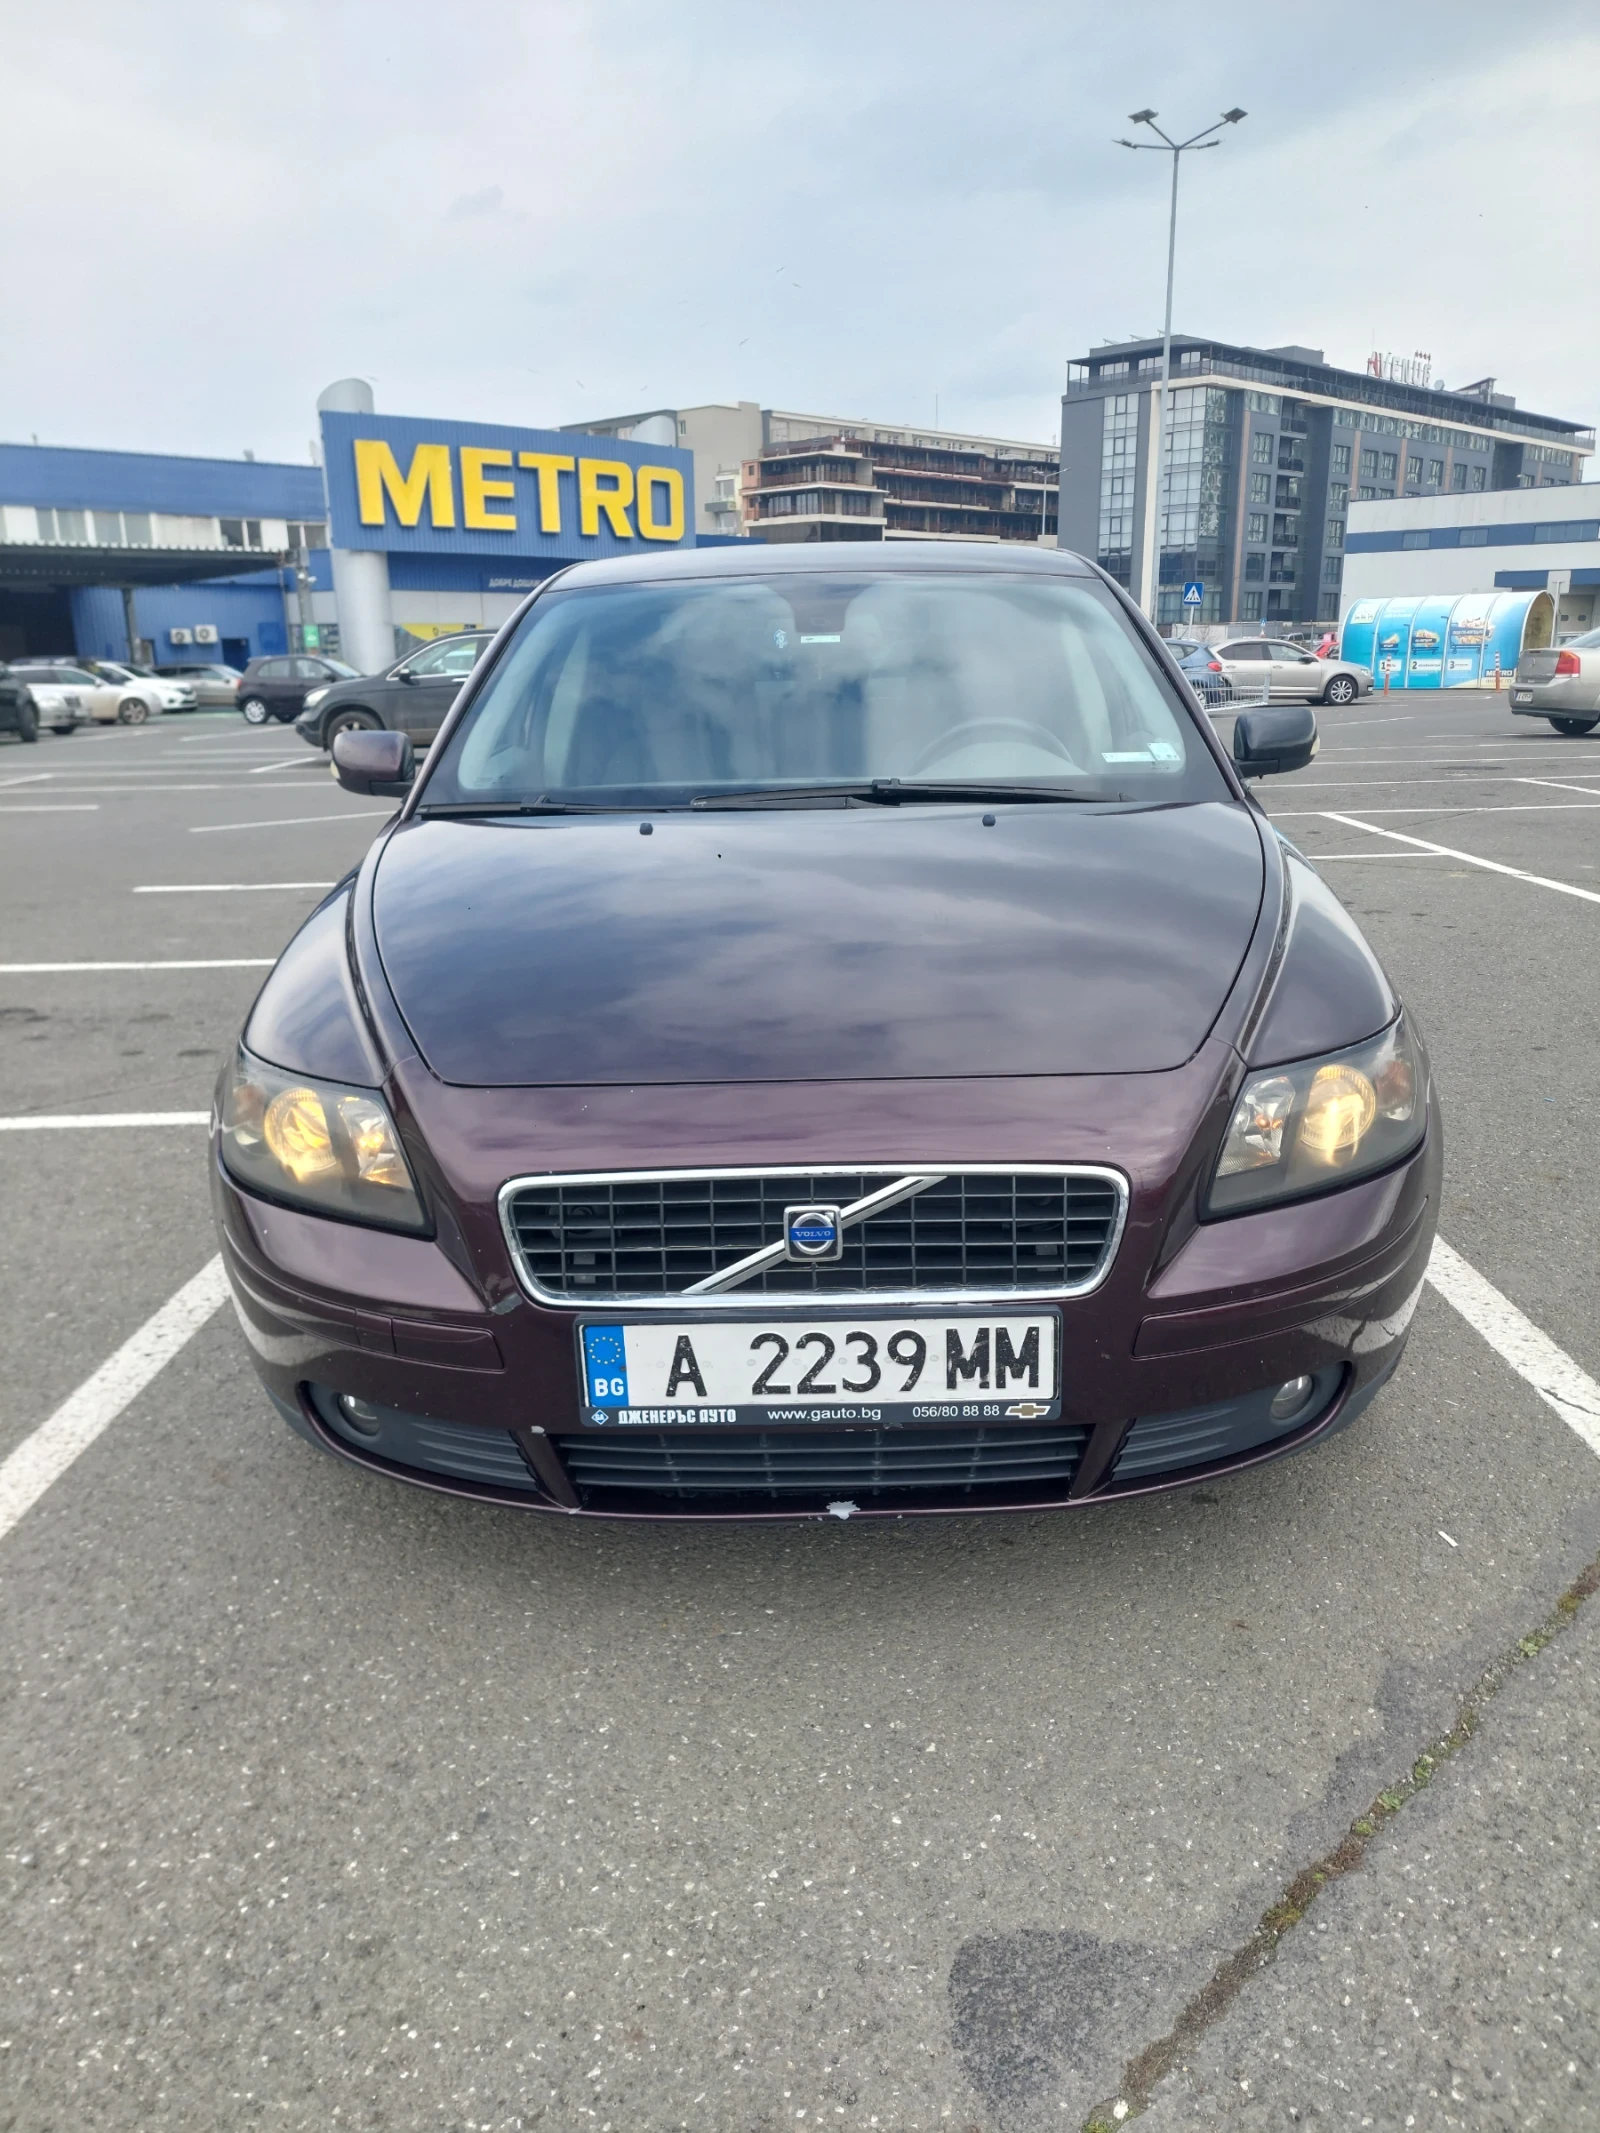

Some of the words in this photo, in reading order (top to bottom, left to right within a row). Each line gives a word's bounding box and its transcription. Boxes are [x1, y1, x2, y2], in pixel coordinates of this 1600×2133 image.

[1366, 351, 1432, 387] AVENUE
[354, 438, 686, 541] METRO
[1412, 661, 1418, 670] 2
[1449, 661, 1455, 669] 3
[665, 1335, 707, 1398] A
[750, 1329, 927, 1395] 2239
[946, 1326, 1039, 1389] MM
[594, 1377, 624, 1397] BG
[767, 1407, 881, 1421] www.gauto.bg
[912, 1405, 958, 1417] 056/80
[962, 1405, 979, 1416] 88
[983, 1404, 1000, 1416] 88
